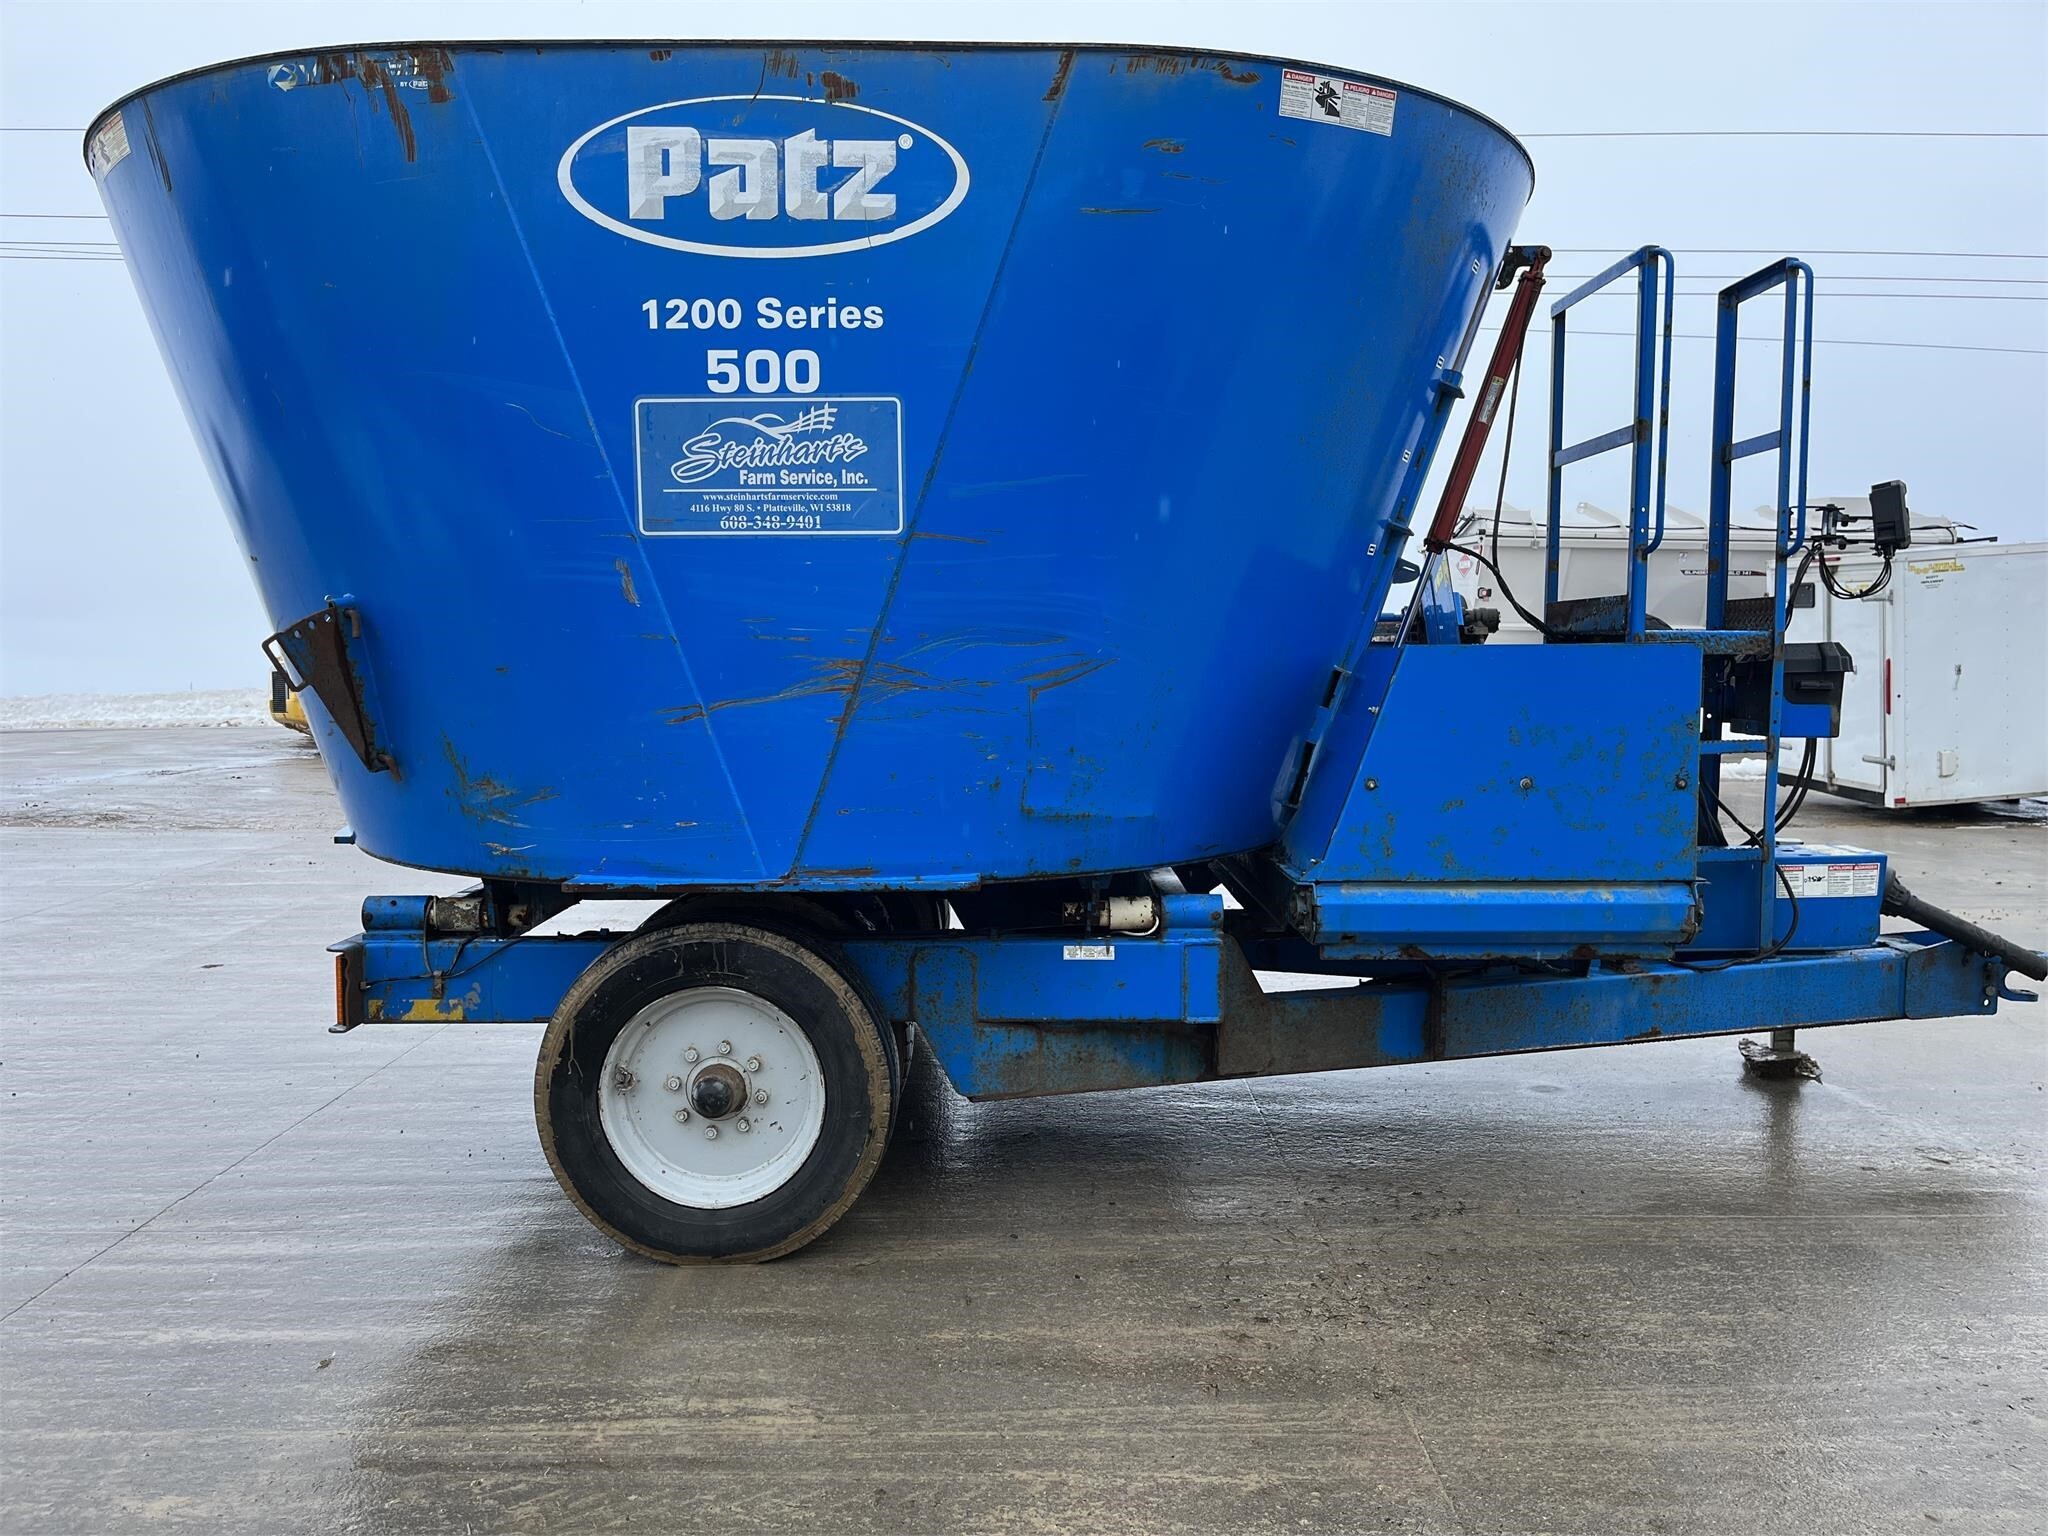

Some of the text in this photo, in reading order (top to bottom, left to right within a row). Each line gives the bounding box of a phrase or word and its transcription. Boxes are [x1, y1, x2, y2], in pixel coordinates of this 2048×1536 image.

[1291, 73, 1314, 82] DANGER
[1349, 85, 1370, 95] PELIGRO
[1376, 90, 1395, 99] DANGER
[642, 297, 884, 329] 1200 Series
[706, 349, 820, 393] 500
[670, 432, 868, 483] Steinhart's
[739, 469, 869, 487] Farm Service, Inc.
[702, 492, 838, 501] www.steinhartsfarmservice.com
[690, 504, 851, 515] 4116 Hwy 80 S. Platteville, WI 53818
[720, 515, 821, 529] 608-348-9401
